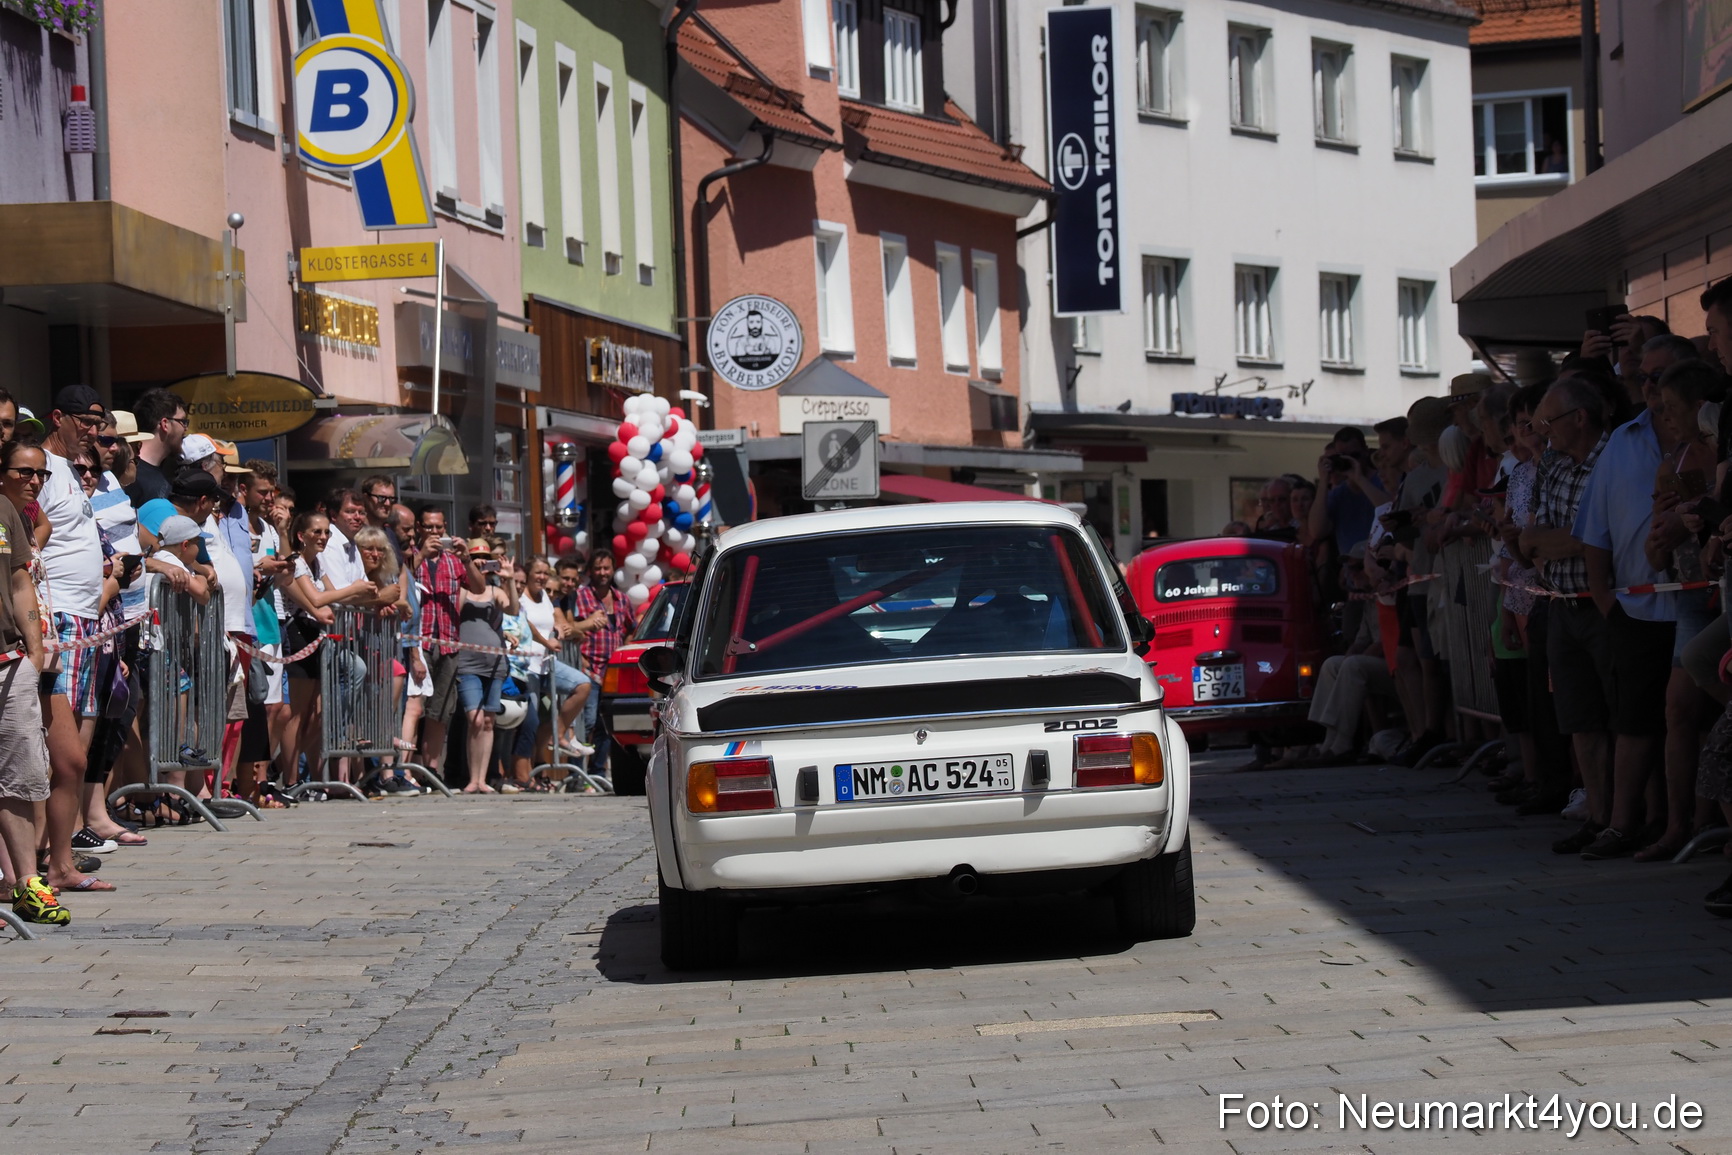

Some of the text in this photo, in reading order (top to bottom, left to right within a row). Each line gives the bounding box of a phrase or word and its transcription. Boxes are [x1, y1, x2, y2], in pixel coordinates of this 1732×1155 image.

[310, 68, 369, 133] B
[1091, 34, 1114, 286] TOM TAILOR
[308, 253, 428, 272] KLOSTERGASSE 4
[747, 300, 793, 331] FRISEURE
[187, 399, 312, 415] GOLDSCHMIEDE
[802, 397, 870, 420] Creppresso
[198, 420, 267, 430] JUTTA ROTHER
[823, 477, 858, 491] ZONE
[1165, 588, 1180, 598] 60
[1183, 585, 1218, 596] Jahre
[1221, 582, 1244, 592] Fiat
[1203, 667, 1223, 682] SC
[1197, 682, 1241, 698] F 574
[1044, 718, 1118, 733] 2002
[996, 758, 1008, 768] 05
[853, 759, 994, 796] NM AC 524
[998, 777, 1009, 786] 10
[841, 786, 849, 795] D
